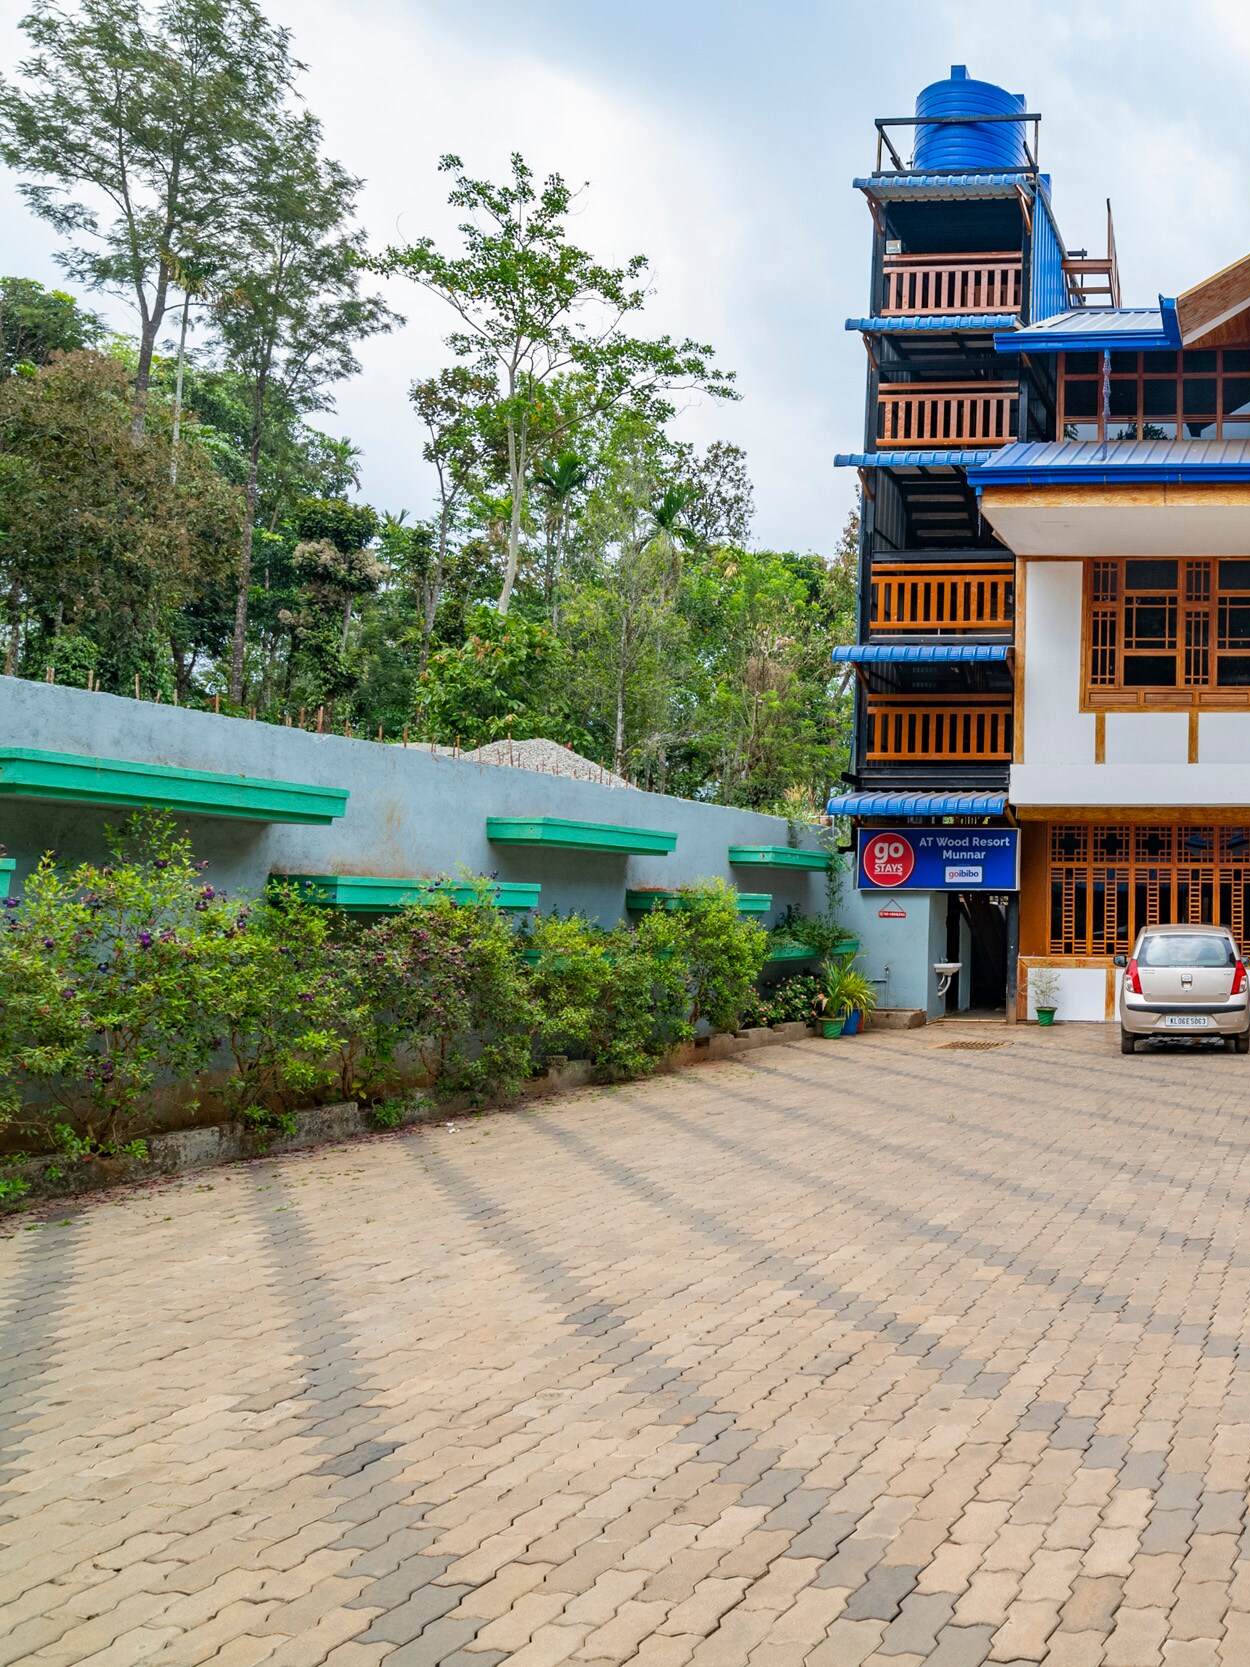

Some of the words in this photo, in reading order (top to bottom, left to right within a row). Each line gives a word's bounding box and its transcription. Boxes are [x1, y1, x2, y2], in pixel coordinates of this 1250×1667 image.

[919, 837, 933, 847] AT
[936, 837, 969, 847] Wood
[972, 837, 1010, 847] Resort
[874, 842, 904, 864] go
[942, 850, 986, 860] Munnar
[874, 864, 903, 872] STAYS
[948, 869, 979, 879] goibibo
